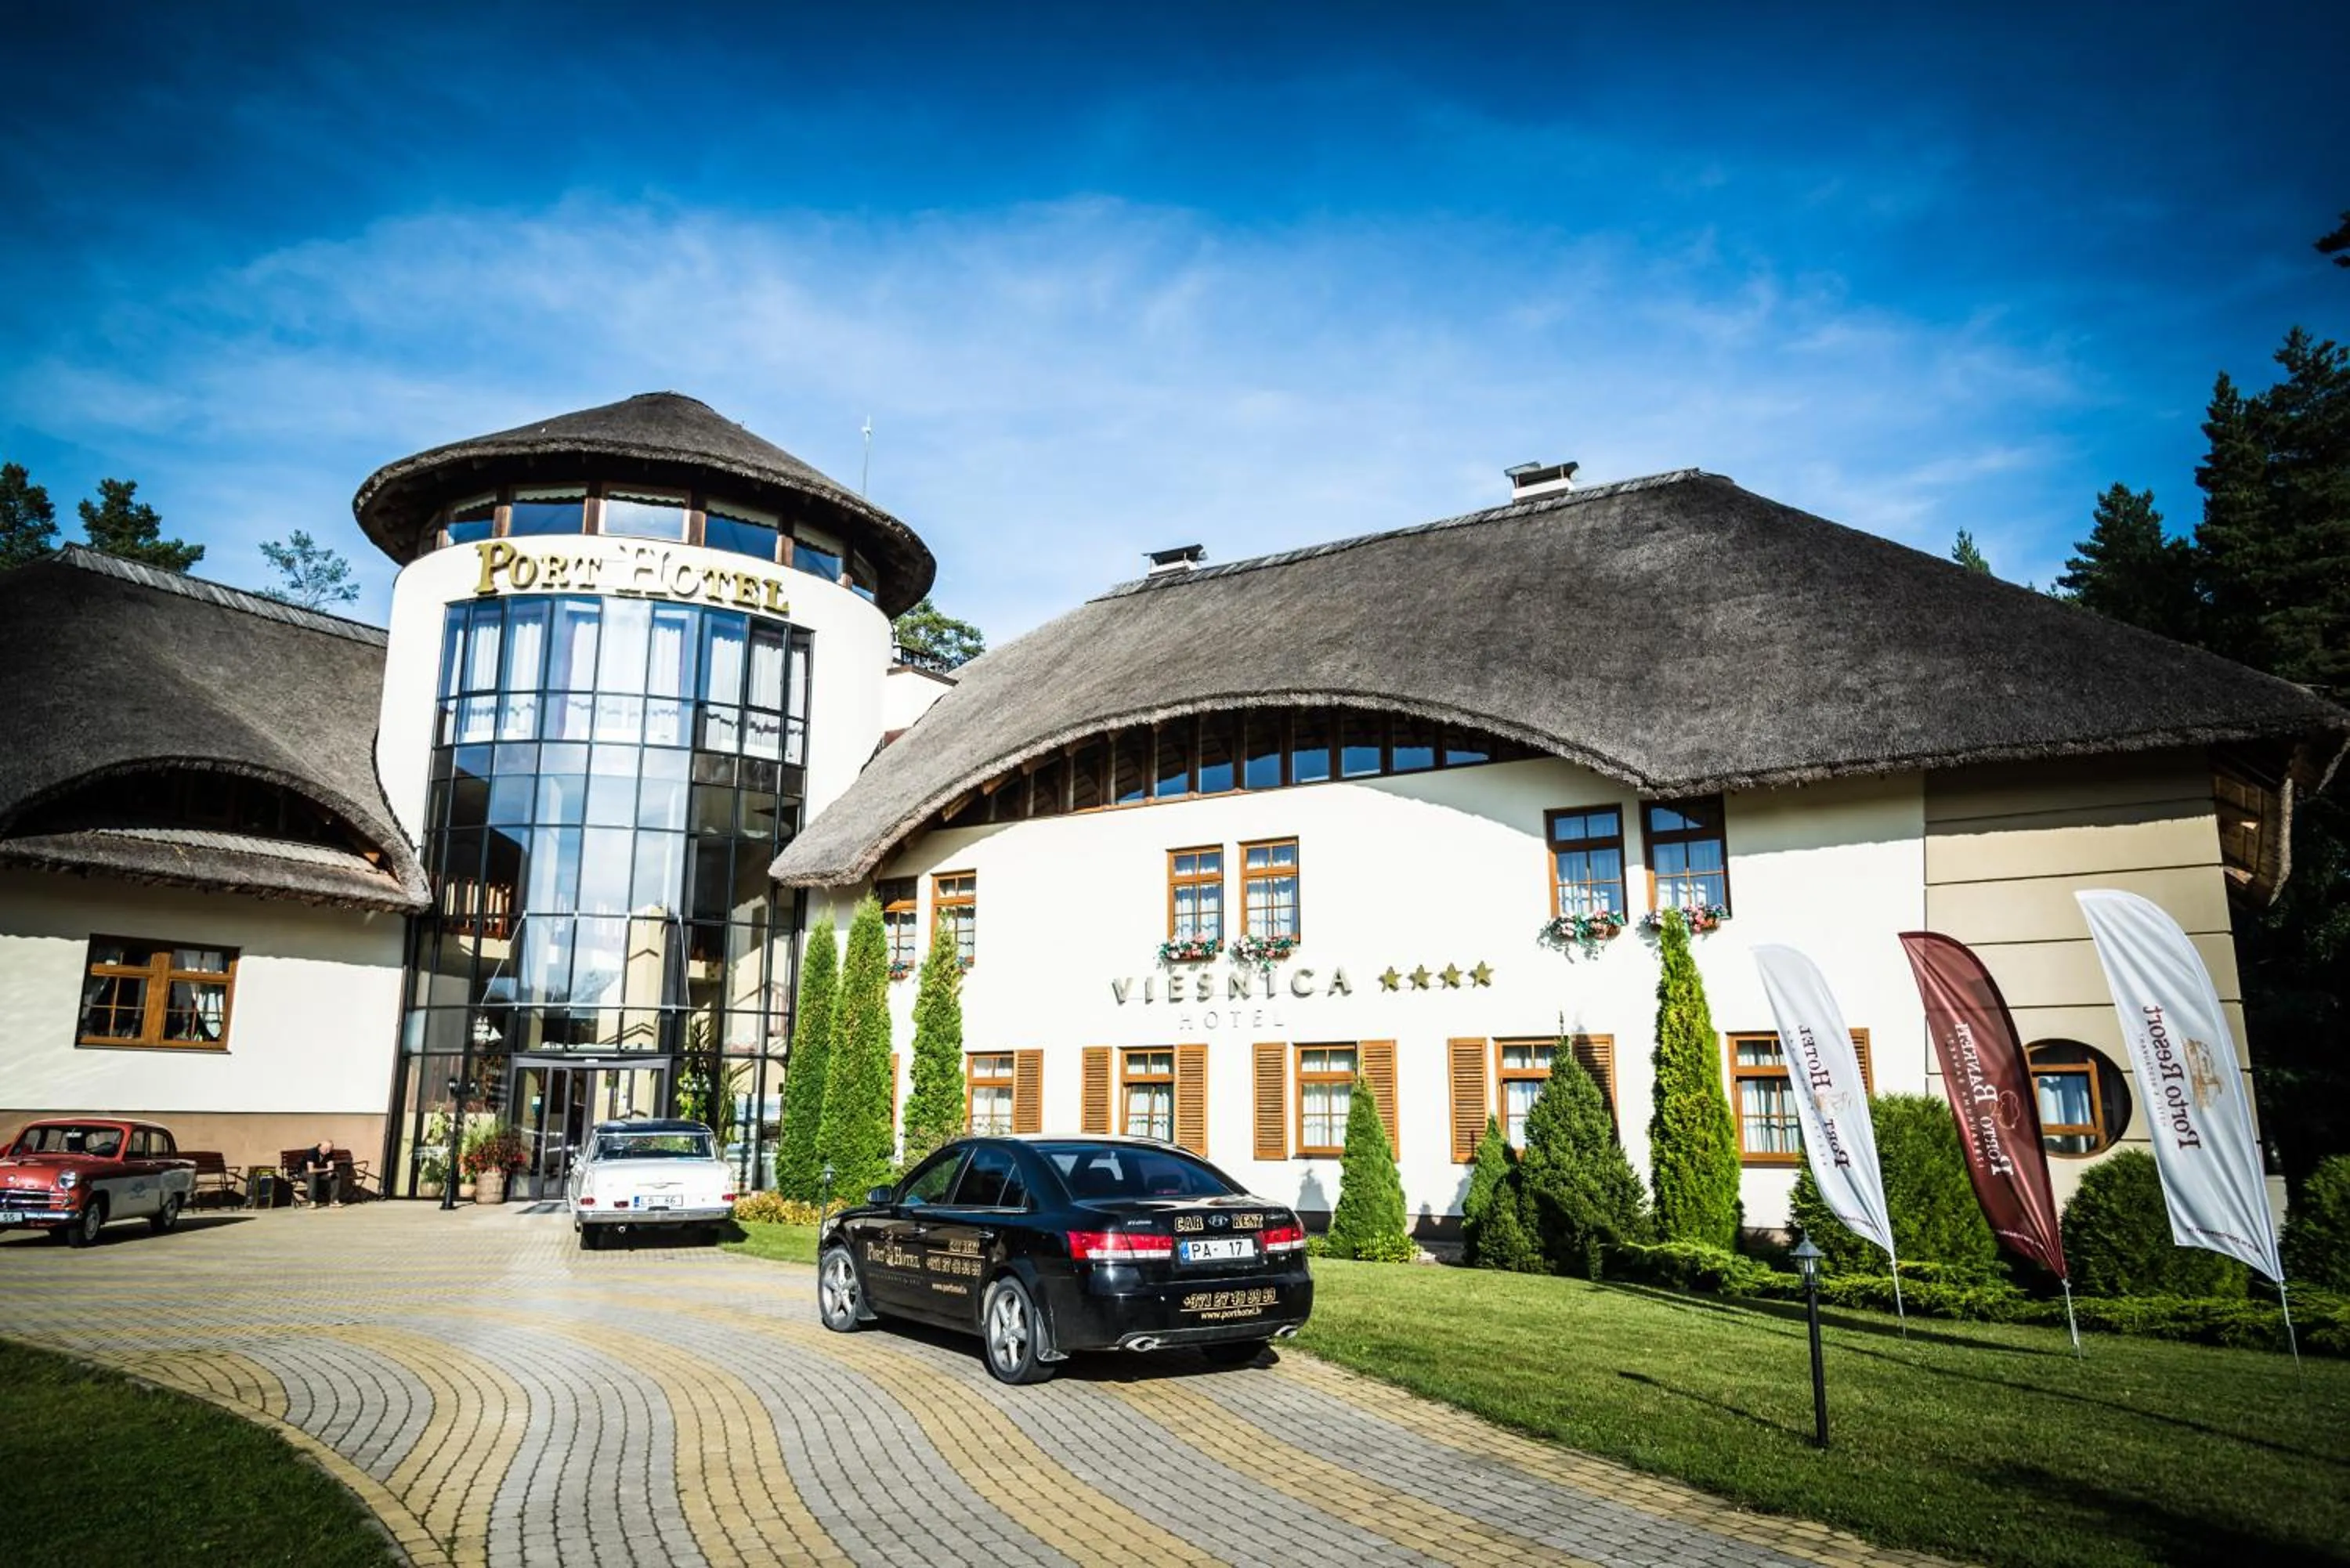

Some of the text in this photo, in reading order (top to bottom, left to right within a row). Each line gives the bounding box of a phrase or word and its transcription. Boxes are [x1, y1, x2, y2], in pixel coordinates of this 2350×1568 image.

[474, 540, 790, 618] PORT HOTEL
[1178, 1009, 1285, 1030] HOTEL
[1175, 1216, 1204, 1232] CAR
